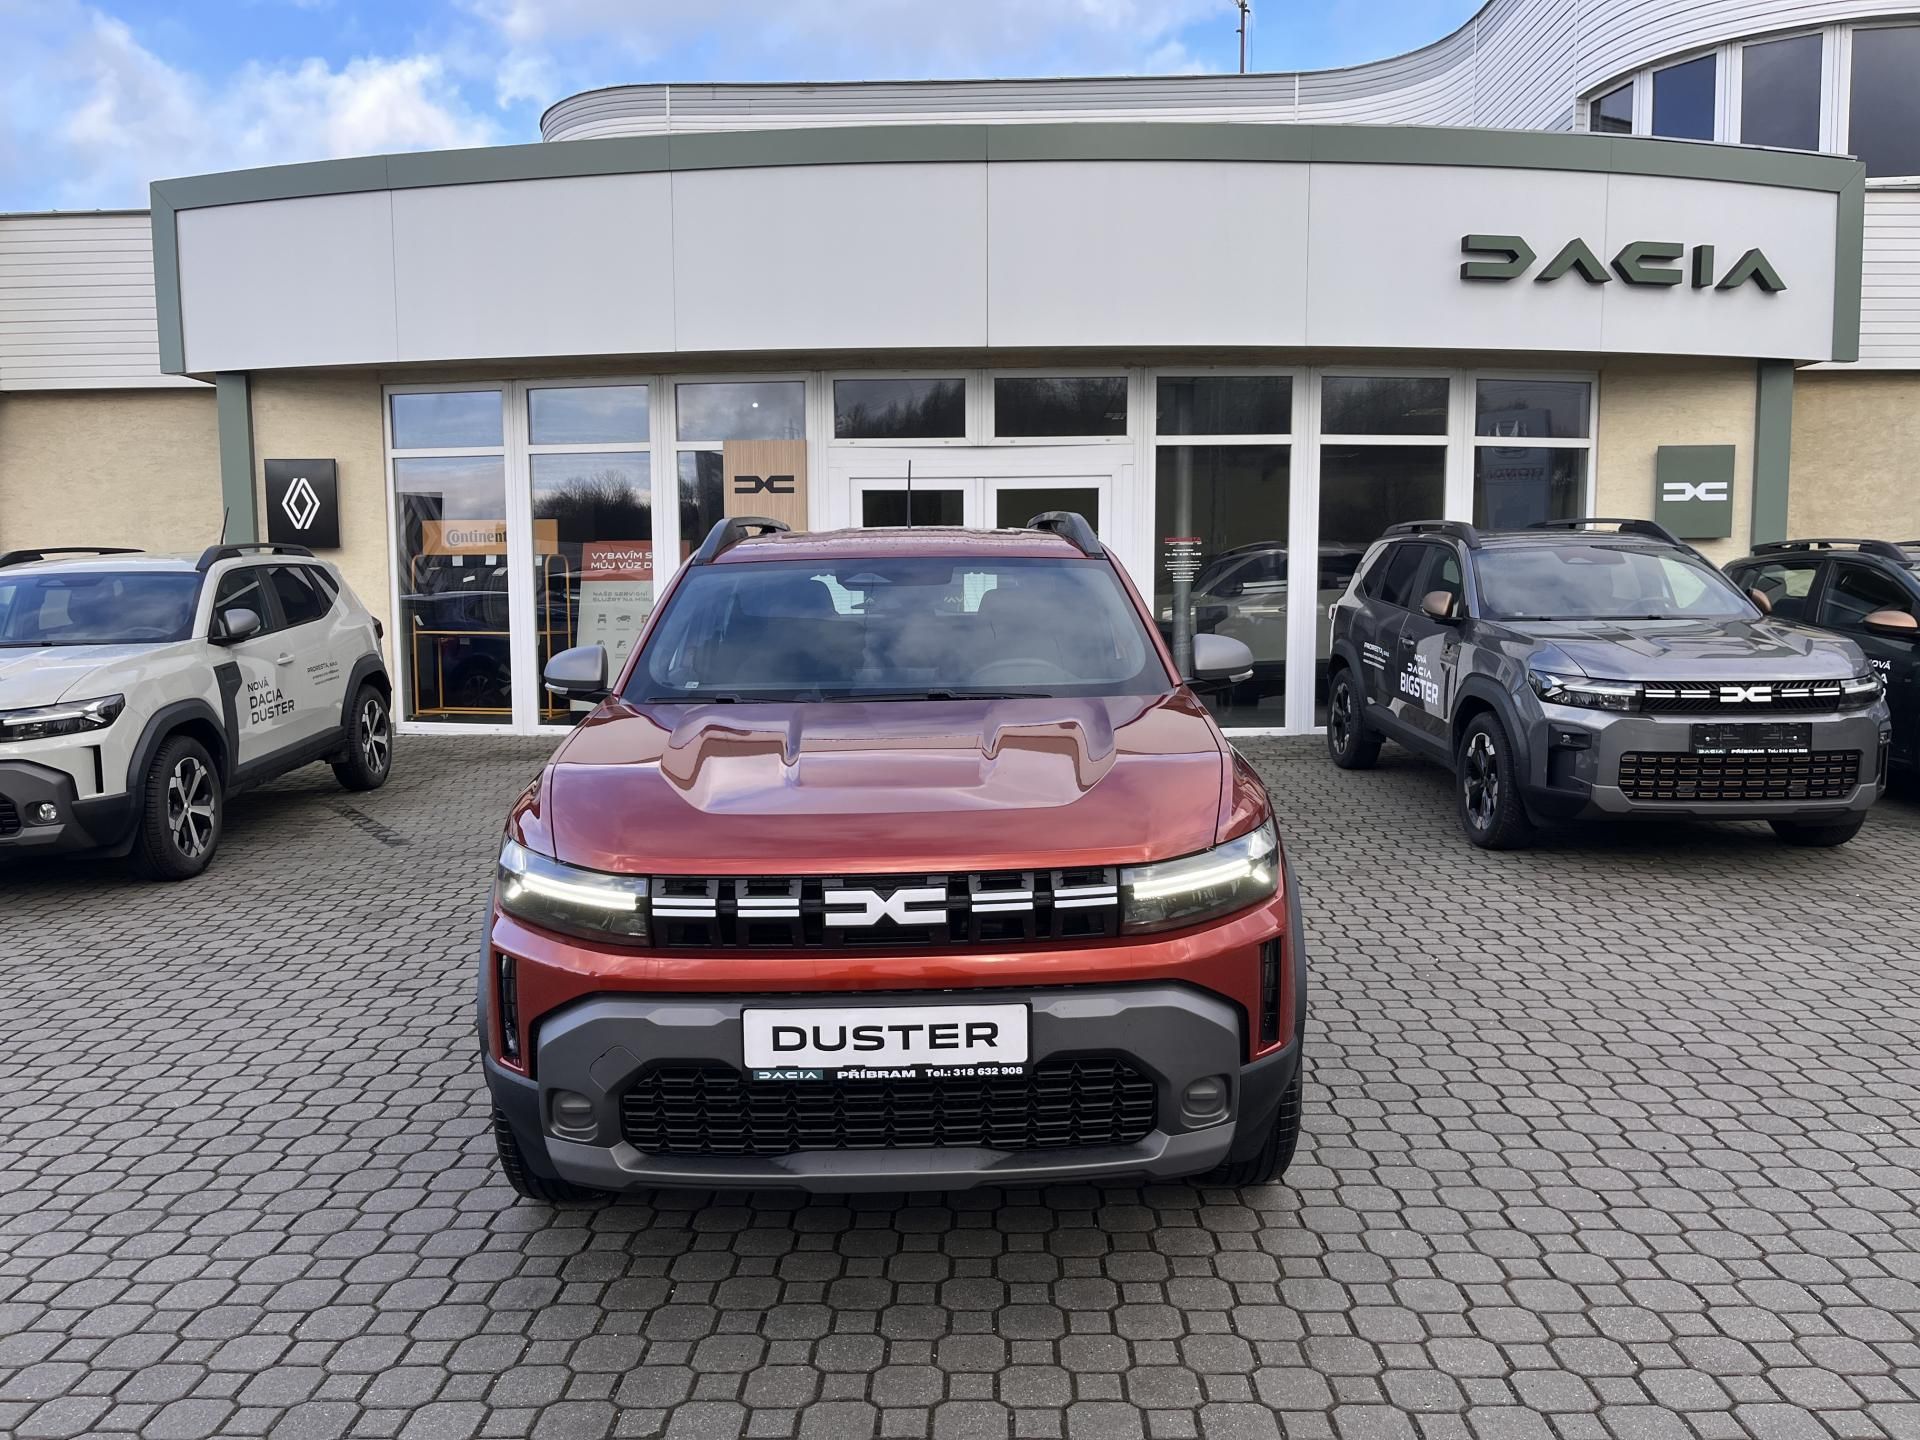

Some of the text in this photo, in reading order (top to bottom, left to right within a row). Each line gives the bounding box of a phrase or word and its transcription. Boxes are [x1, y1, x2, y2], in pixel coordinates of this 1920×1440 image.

[1460, 234, 1788, 292] DACIA
[591, 550, 643, 560] VYBAVÍM
[590, 559, 616, 569] MŮJ
[618, 559, 642, 569] VŮZ
[1407, 662, 1432, 679] DACIA
[1870, 659, 1891, 670] OVÁ
[247, 676, 270, 692] NOVÁ
[1400, 671, 1439, 705] BIGSTER
[249, 688, 283, 710] DACIA
[251, 699, 295, 725] DUSTER
[771, 1022, 999, 1052] DUSTER
[758, 1066, 1023, 1079] DACIA PŘÍBRAM Tel.: 318 632 908
